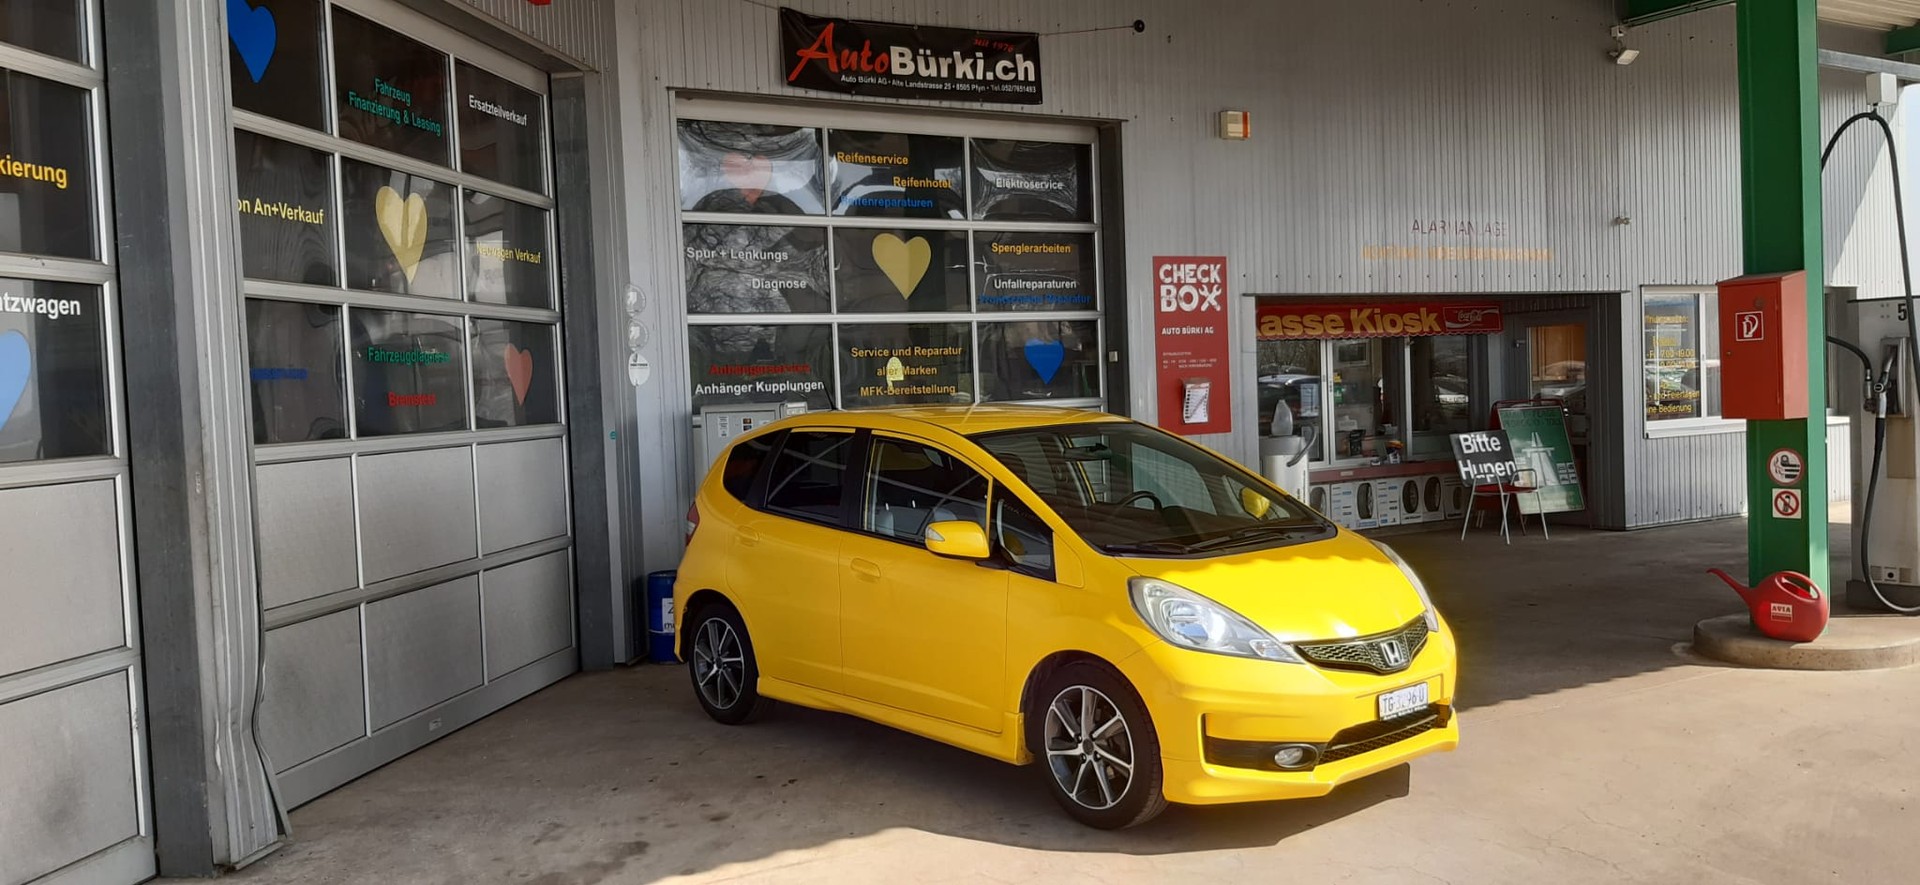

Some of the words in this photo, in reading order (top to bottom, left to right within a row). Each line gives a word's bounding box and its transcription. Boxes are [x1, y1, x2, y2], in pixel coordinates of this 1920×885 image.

[841, 74, 857, 83] Auto
[858, 75, 877, 84] Bürki
[878, 77, 888, 85] AG
[904, 80, 943, 89] Landstrasse
[374, 77, 411, 107] Fahrzeug
[349, 91, 401, 125] Finanzierung
[403, 111, 409, 124] &
[411, 112, 441, 137] Leasing
[468, 94, 527, 127] Ersatzteilverkauf
[836, 151, 909, 165] Reifenservice
[892, 176, 952, 189] Reifenhotel
[995, 177, 1063, 190] Elektroservice
[840, 195, 933, 209] Reifenreparaturen
[254, 198, 324, 225] An+Verkauf
[1411, 219, 1508, 237] ALARMANAGE
[476, 240, 514, 262] Neuwagen
[514, 248, 541, 264] Verkauf
[686, 246, 716, 261] Spur
[720, 250, 727, 258] +
[730, 249, 789, 263] Lenkungs
[991, 242, 1071, 255] Spenglerarbeiten
[1159, 263, 1221, 284] CHECK
[752, 278, 807, 292] Diagnose
[994, 279, 1077, 291] Unfallreparaturen
[1160, 284, 1222, 312] BOX
[1897, 303, 1908, 321] 5
[1161, 327, 1181, 335] AUTO
[1181, 325, 1203, 335] BÜRKI
[1204, 326, 1214, 334] AG
[1257, 311, 1345, 336] asse
[1350, 307, 1441, 334] Kiosk
[367, 346, 451, 366] Fahrzeugdiagnose
[851, 347, 889, 358] Service
[892, 346, 911, 356] und
[914, 346, 962, 358] Reparatur
[902, 365, 937, 375] Marken
[695, 382, 753, 396] Anhänger
[755, 380, 825, 394] Kupplungen
[860, 384, 956, 397] MFK-Bereitstellung
[1459, 433, 1502, 454] Bitte
[1458, 459, 1517, 483] Hupen
